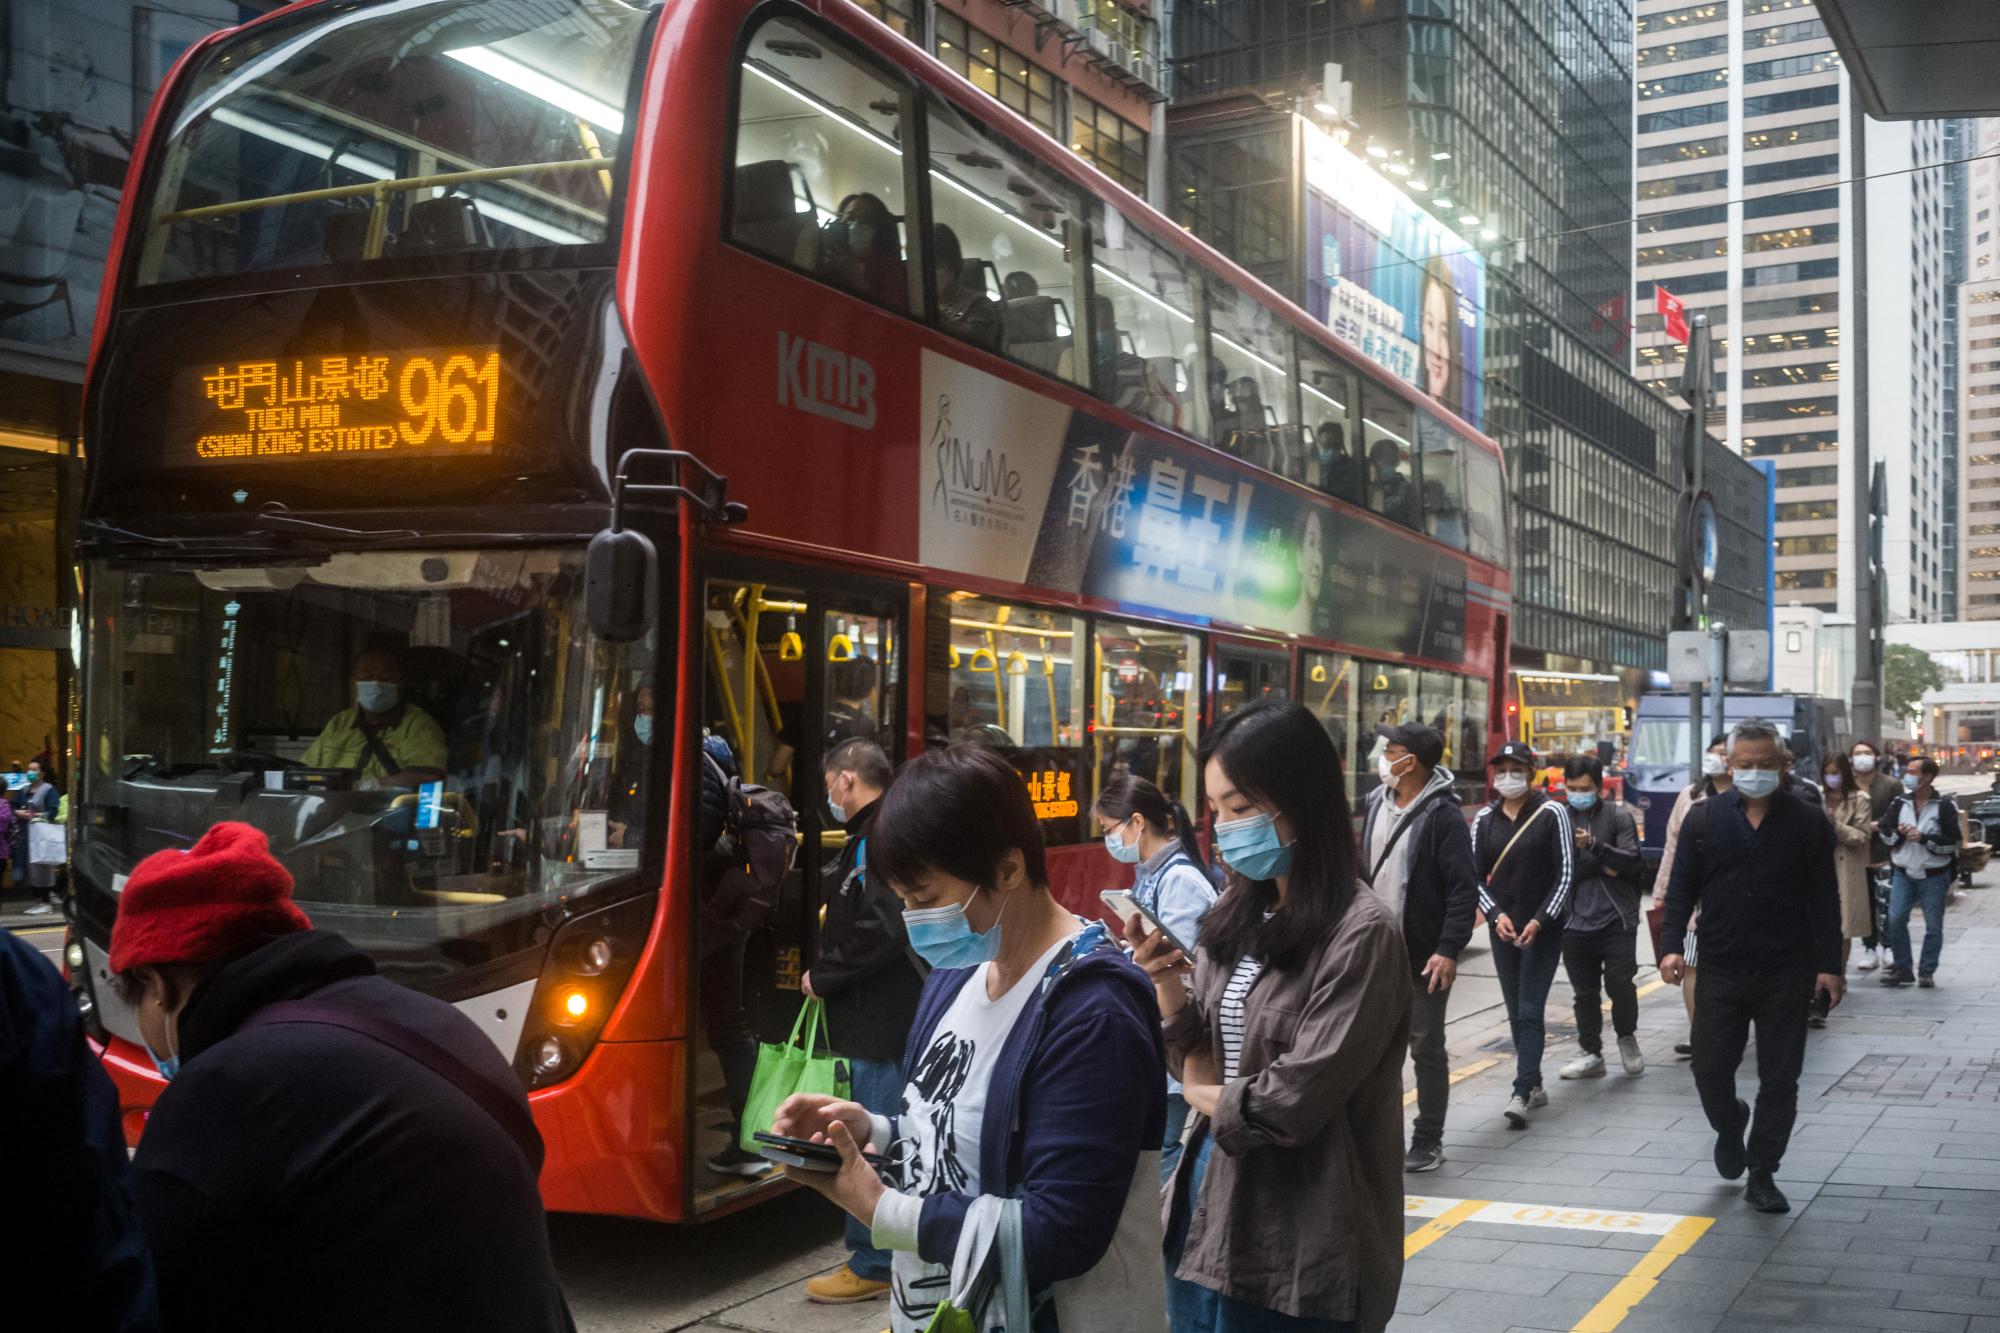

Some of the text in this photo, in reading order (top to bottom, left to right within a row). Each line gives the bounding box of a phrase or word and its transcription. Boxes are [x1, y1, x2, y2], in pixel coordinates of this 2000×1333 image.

[203, 356, 389, 410] 屯門山景邨
[399, 353, 499, 444] 961
[778, 331, 877, 429] KMB
[245, 405, 340, 431] TUEN MUN
[258, 431, 303, 455] KING
[953, 438, 1022, 501] NuMe
